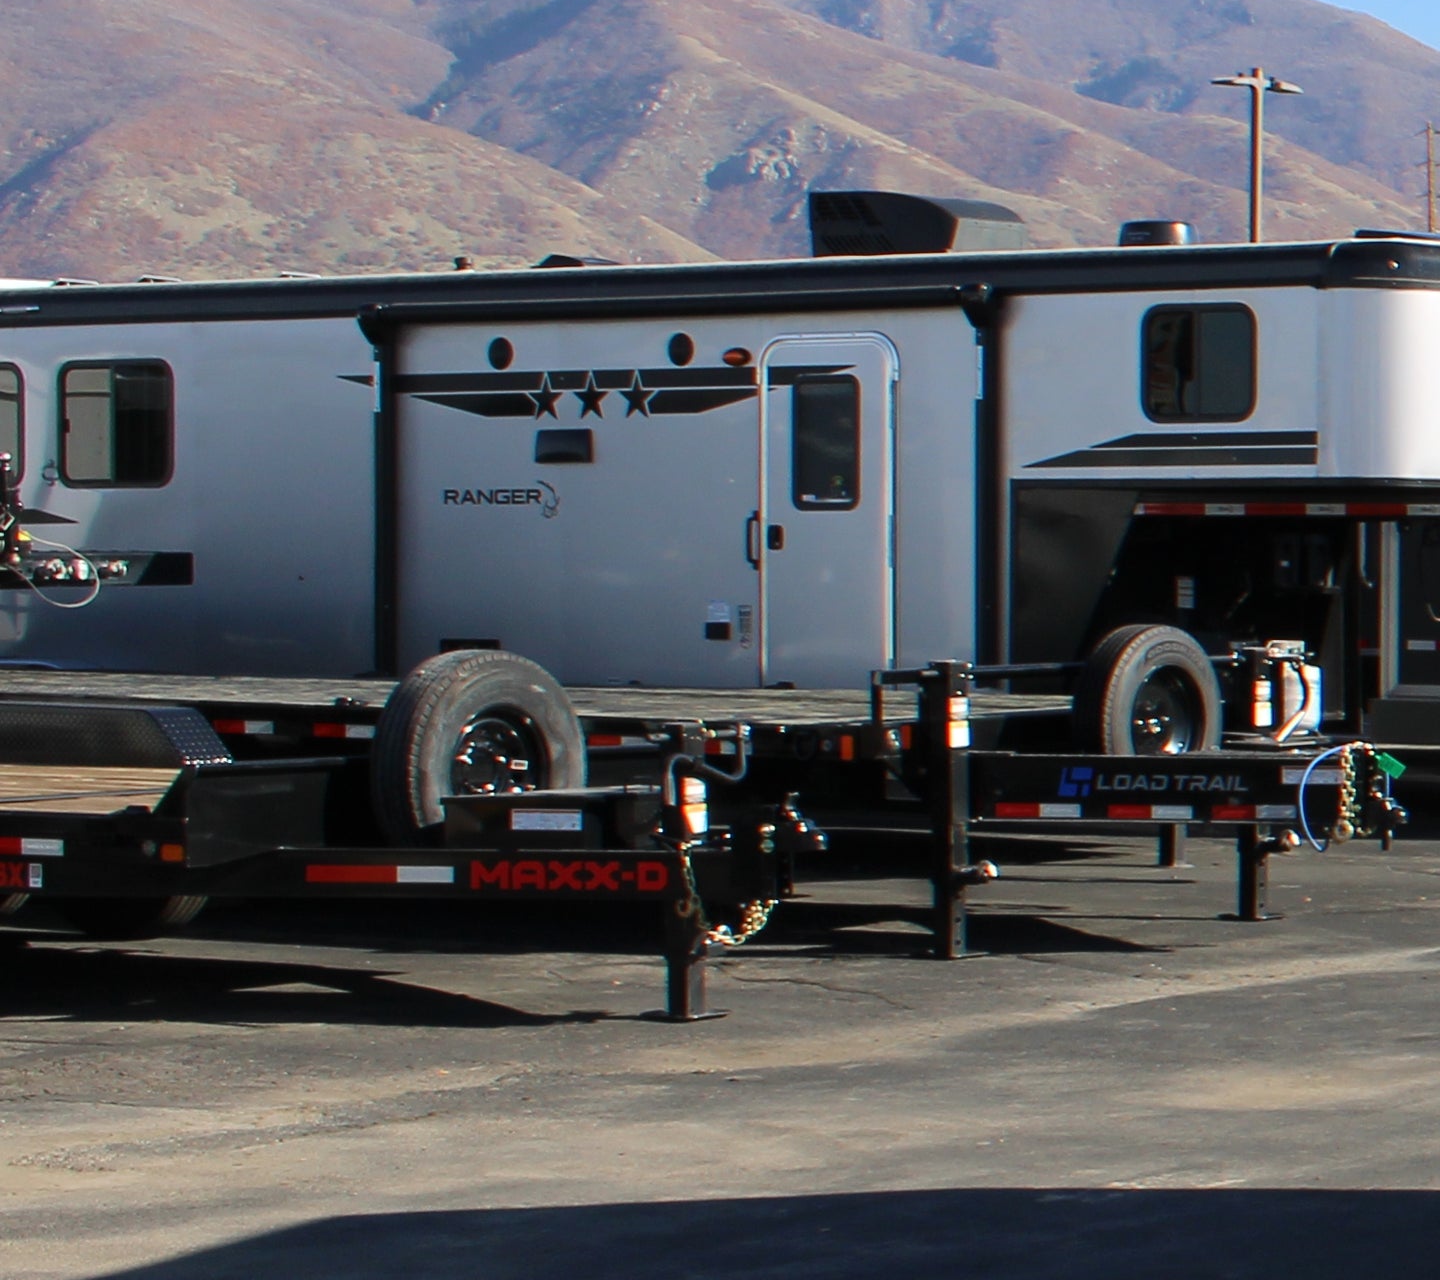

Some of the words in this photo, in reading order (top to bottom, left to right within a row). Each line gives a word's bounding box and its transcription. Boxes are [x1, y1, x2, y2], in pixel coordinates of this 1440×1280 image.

[443, 489, 542, 505] RANGER
[1096, 774, 1169, 791] LOAD
[1174, 775, 1249, 792] TRAIL
[469, 860, 669, 891] MAXX-D
